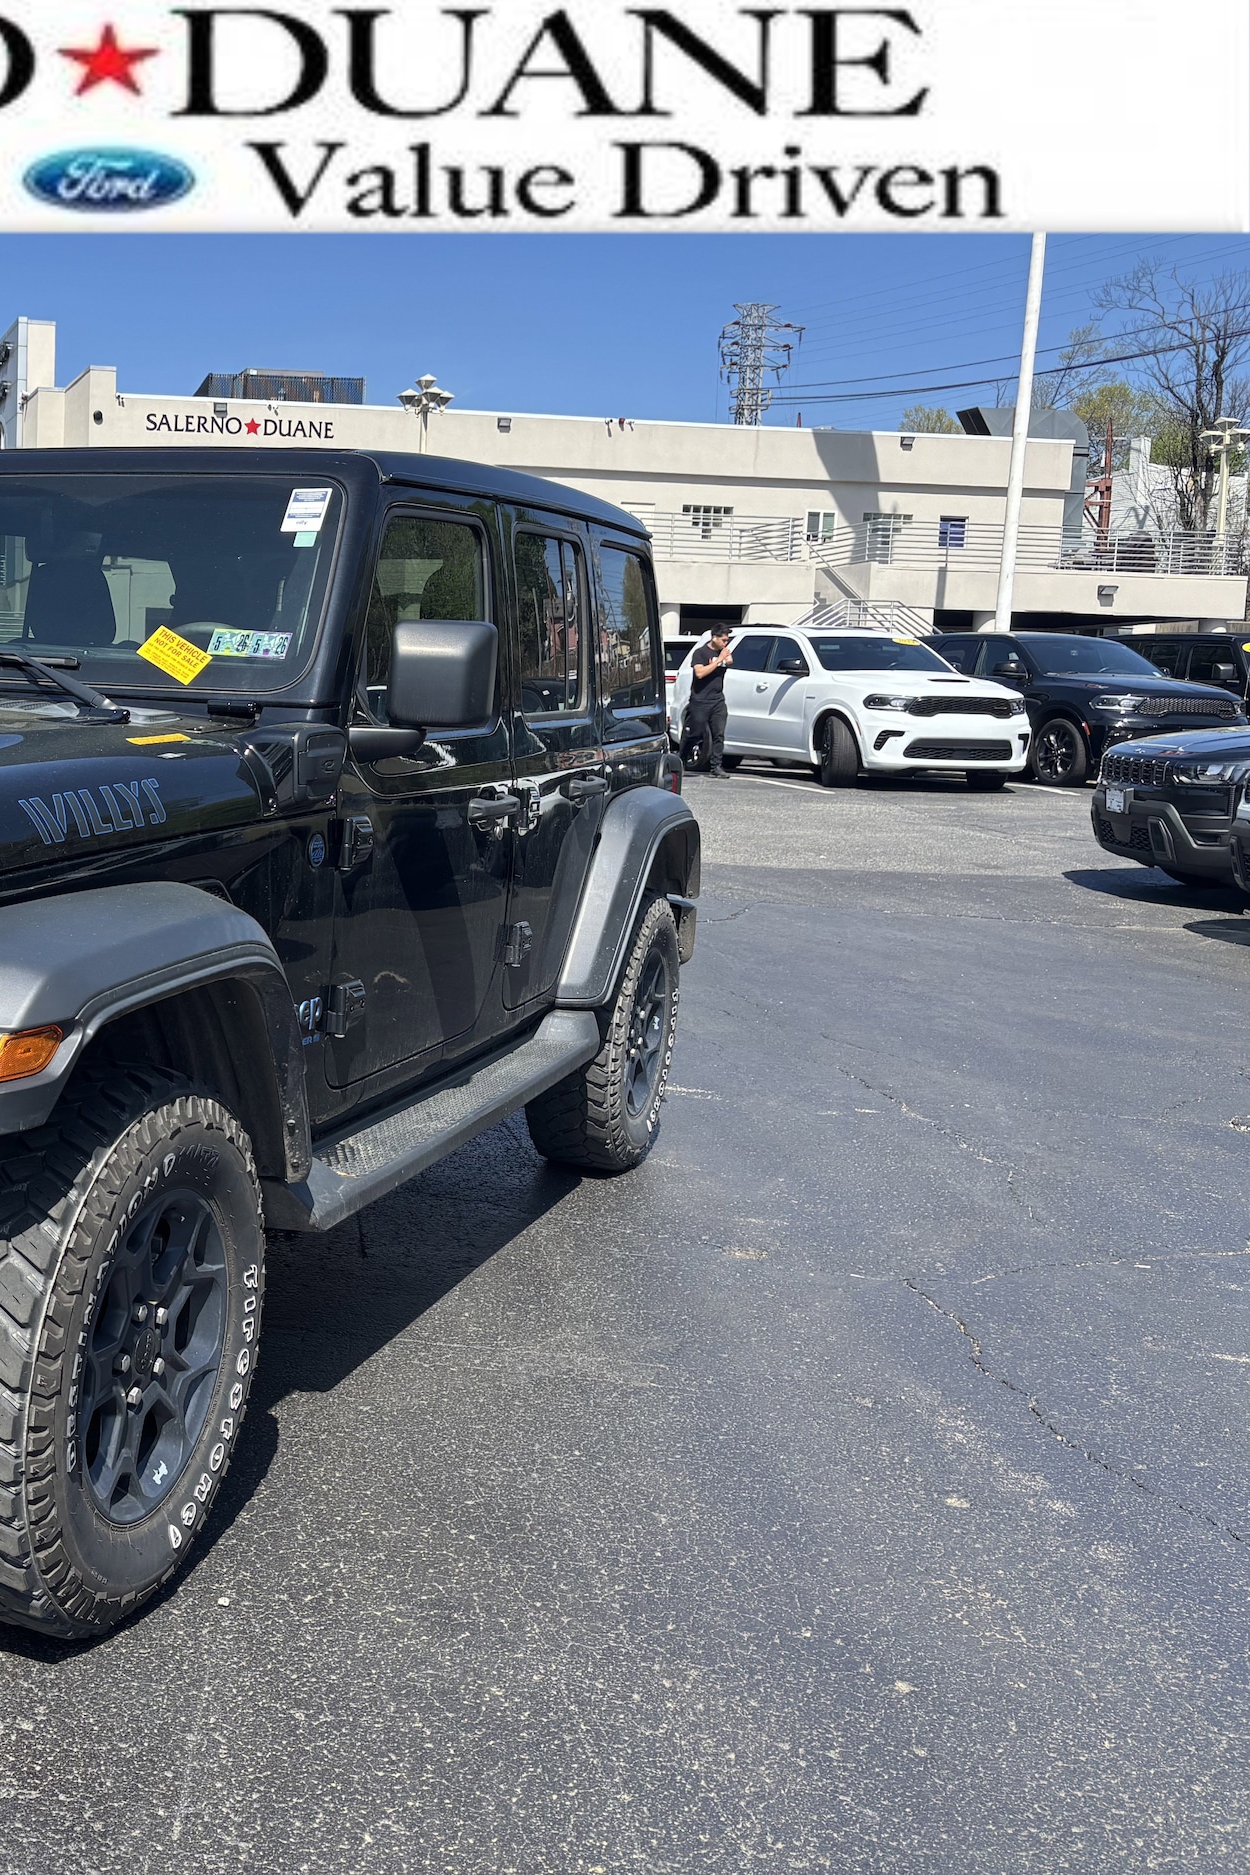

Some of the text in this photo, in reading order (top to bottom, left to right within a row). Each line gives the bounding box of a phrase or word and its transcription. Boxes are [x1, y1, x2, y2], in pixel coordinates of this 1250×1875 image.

[146, 413, 334, 439] SALERNO DUANE
[154, 637, 200, 669] NOT FOR SALE
[159, 629, 177, 644] THIS
[175, 639, 208, 664] VEHICLE
[213, 636, 223, 651] 5
[252, 638, 262, 653] 5
[18, 778, 167, 845] WILLYS
